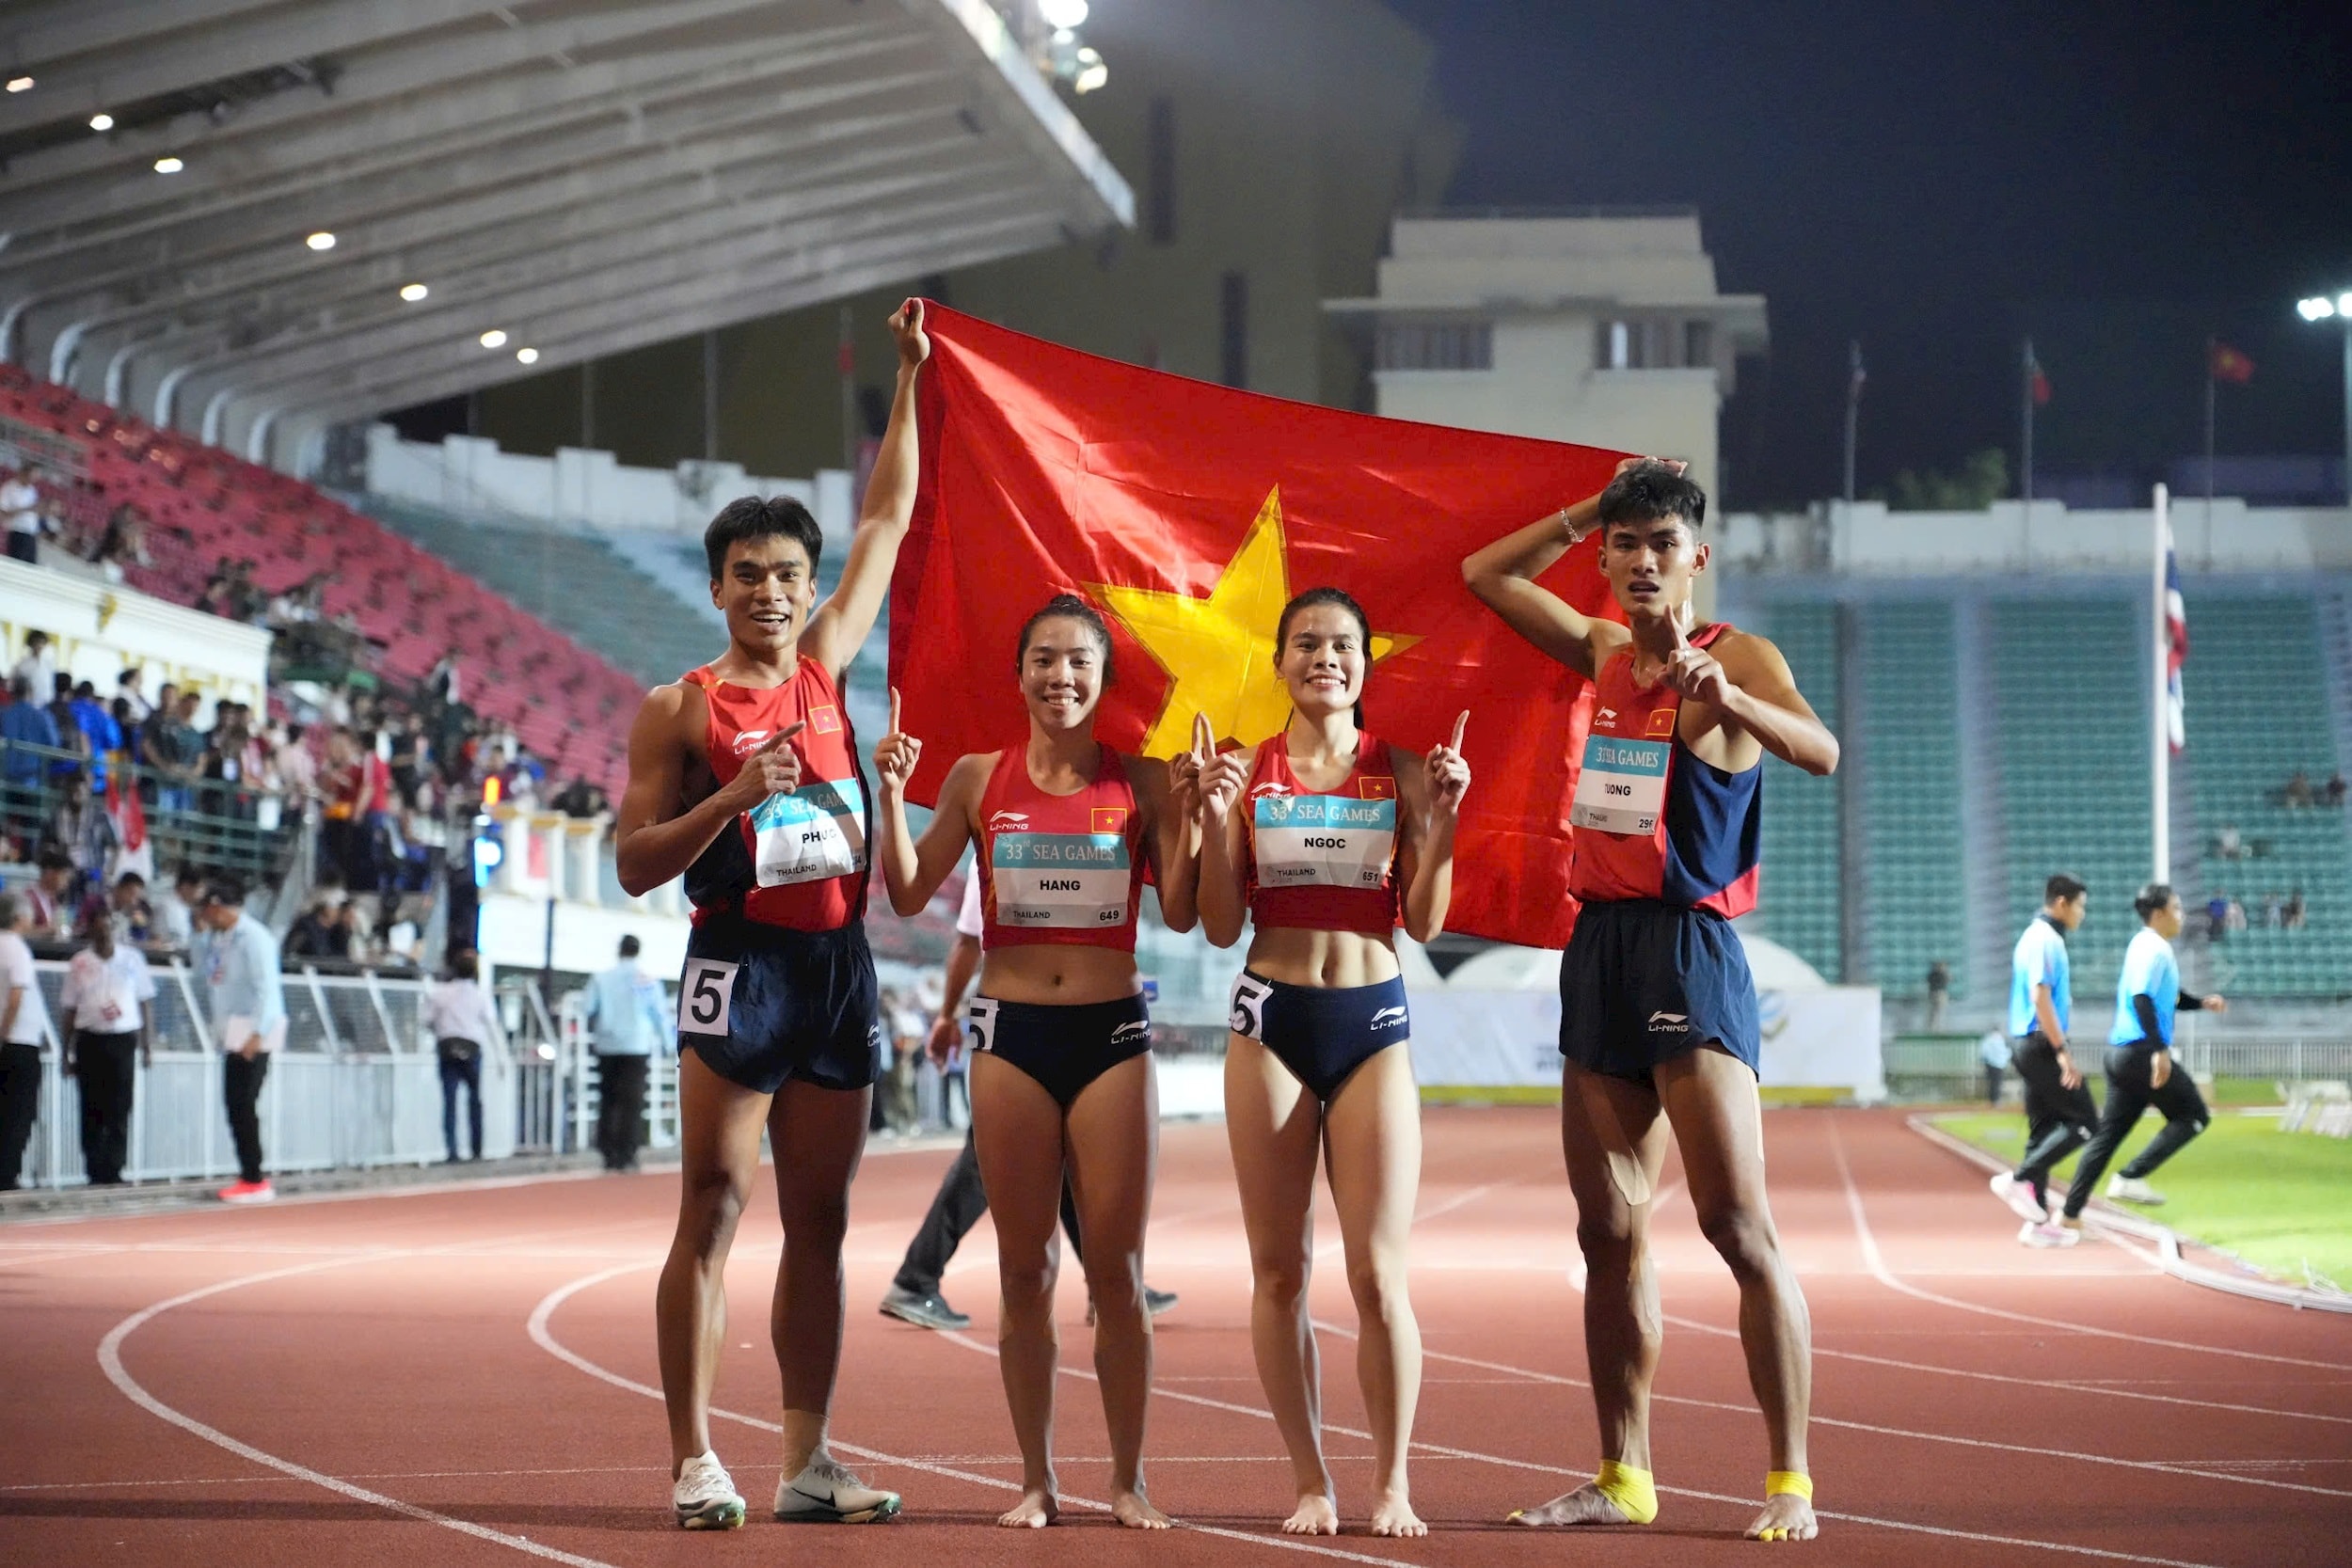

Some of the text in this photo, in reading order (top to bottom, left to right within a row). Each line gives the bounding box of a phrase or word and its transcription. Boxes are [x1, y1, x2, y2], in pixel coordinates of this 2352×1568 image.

[734, 739, 771, 754] LI-NIN
[1618, 750, 1659, 768] GAMES
[1297, 805, 1326, 819] SEA
[1329, 806, 1381, 821] GAMES
[803, 829, 837, 844] PHUC
[1304, 838, 1346, 848] NGOC
[1033, 845, 1060, 860] SEA
[1065, 845, 1115, 861] GAMES
[776, 864, 817, 877] THAILAND
[1278, 868, 1379, 882] THAILAND 651
[1040, 879, 1081, 891] HANG
[1013, 910, 1120, 921] THAILAND 649
[691, 969, 725, 1024] 5
[1231, 985, 1261, 1036] 5
